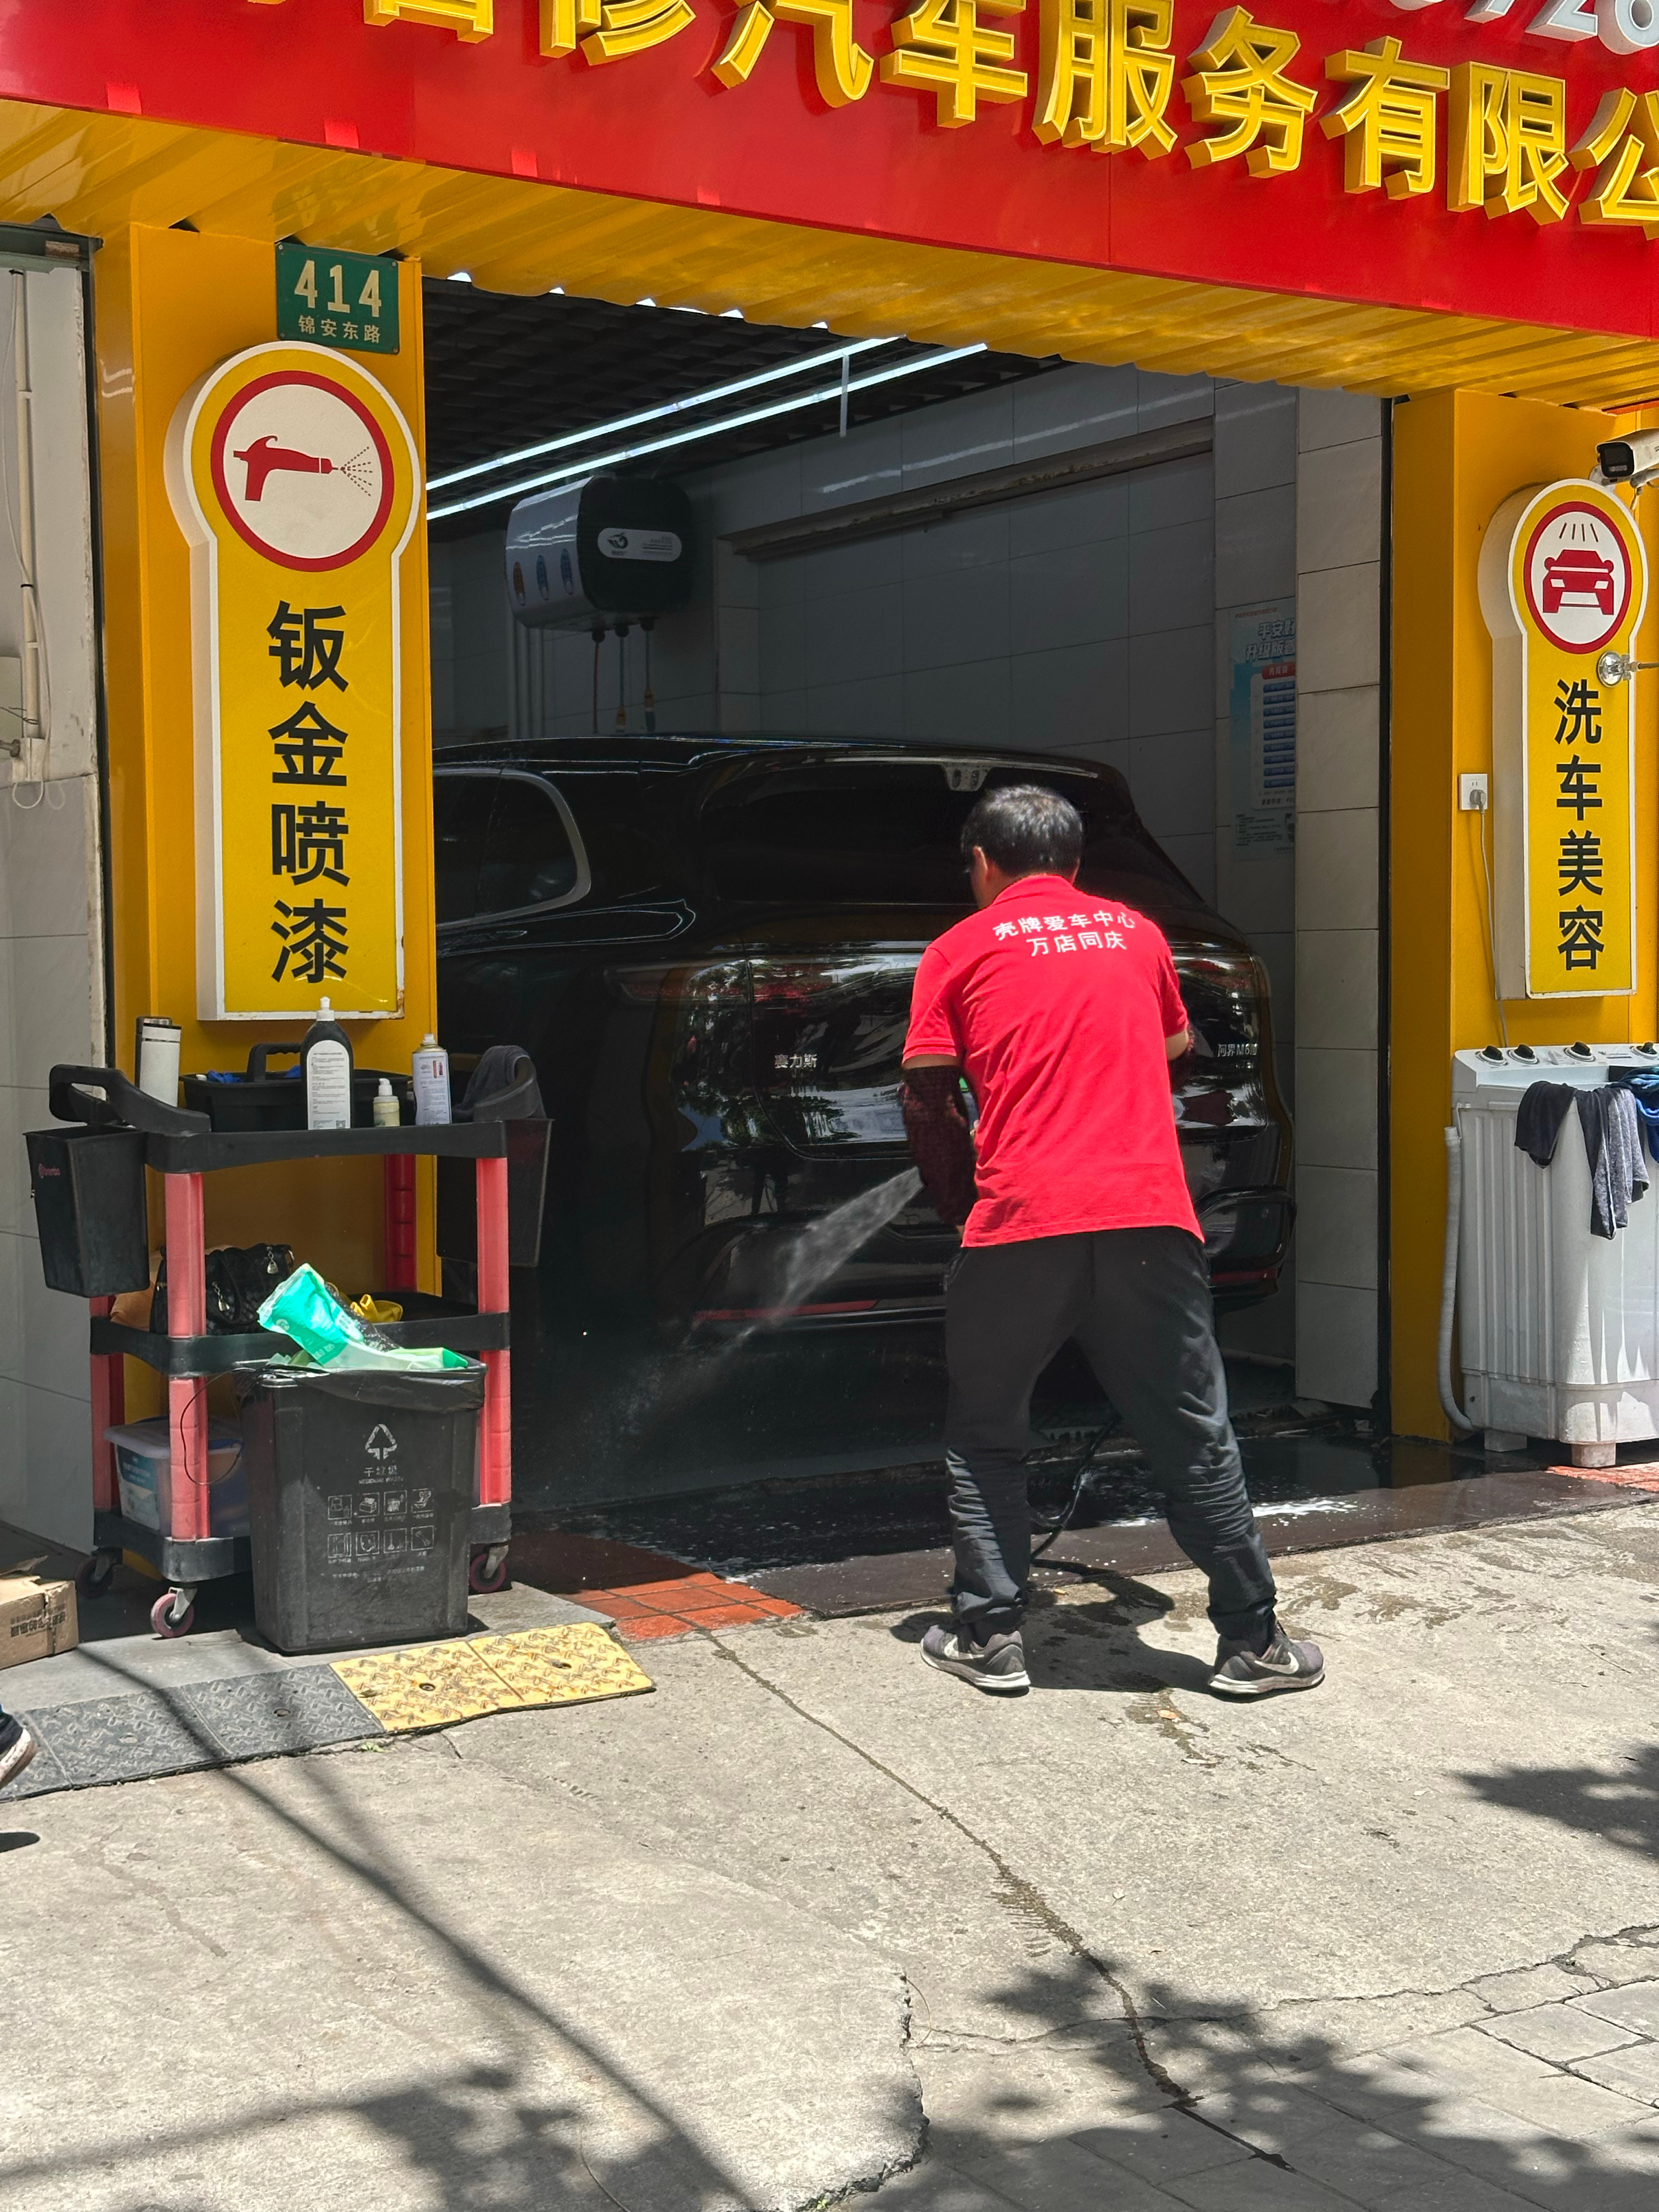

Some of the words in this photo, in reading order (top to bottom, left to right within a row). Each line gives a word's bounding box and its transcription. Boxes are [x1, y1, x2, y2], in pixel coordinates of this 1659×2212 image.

[247, 0, 1659, 240] 汽车服务有限公
[294, 260, 381, 318] 414
[298, 315, 380, 343] 锦安东路
[266, 600, 350, 984] 钣金喷漆
[1554, 679, 1605, 971] 洗车美容
[992, 910, 1136, 941] 壳牌爱车中心
[1026, 931, 1127, 957] 万店同庆
[774, 1053, 817, 1069] 赛力斯
